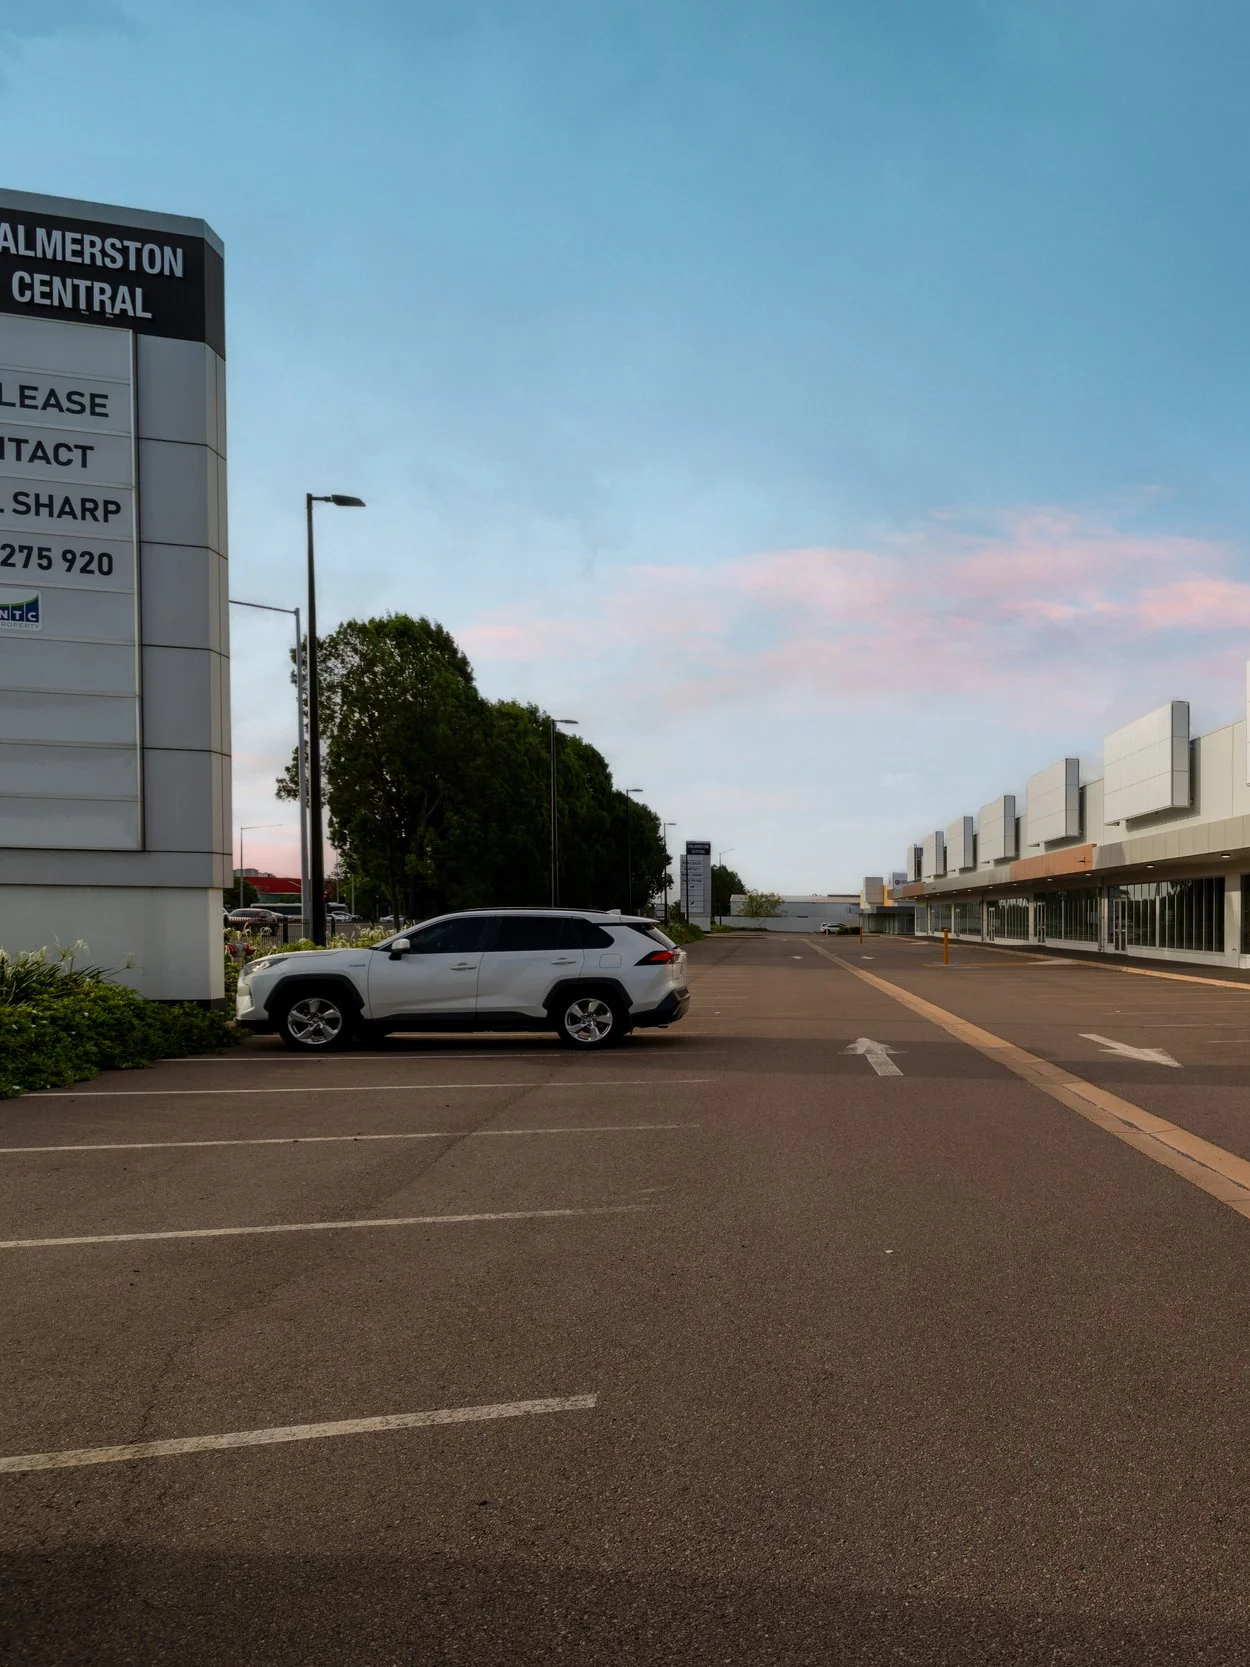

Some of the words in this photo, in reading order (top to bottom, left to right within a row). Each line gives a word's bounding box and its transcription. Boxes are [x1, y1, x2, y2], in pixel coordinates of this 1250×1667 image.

[0, 222, 184, 278] ALMERSTON
[11, 270, 153, 319] CENTRAL
[0, 382, 110, 418] LEASE
[0, 436, 95, 468] TACT
[12, 491, 122, 523] SHARP
[0, 543, 53, 571] 275
[61, 549, 114, 576] 920
